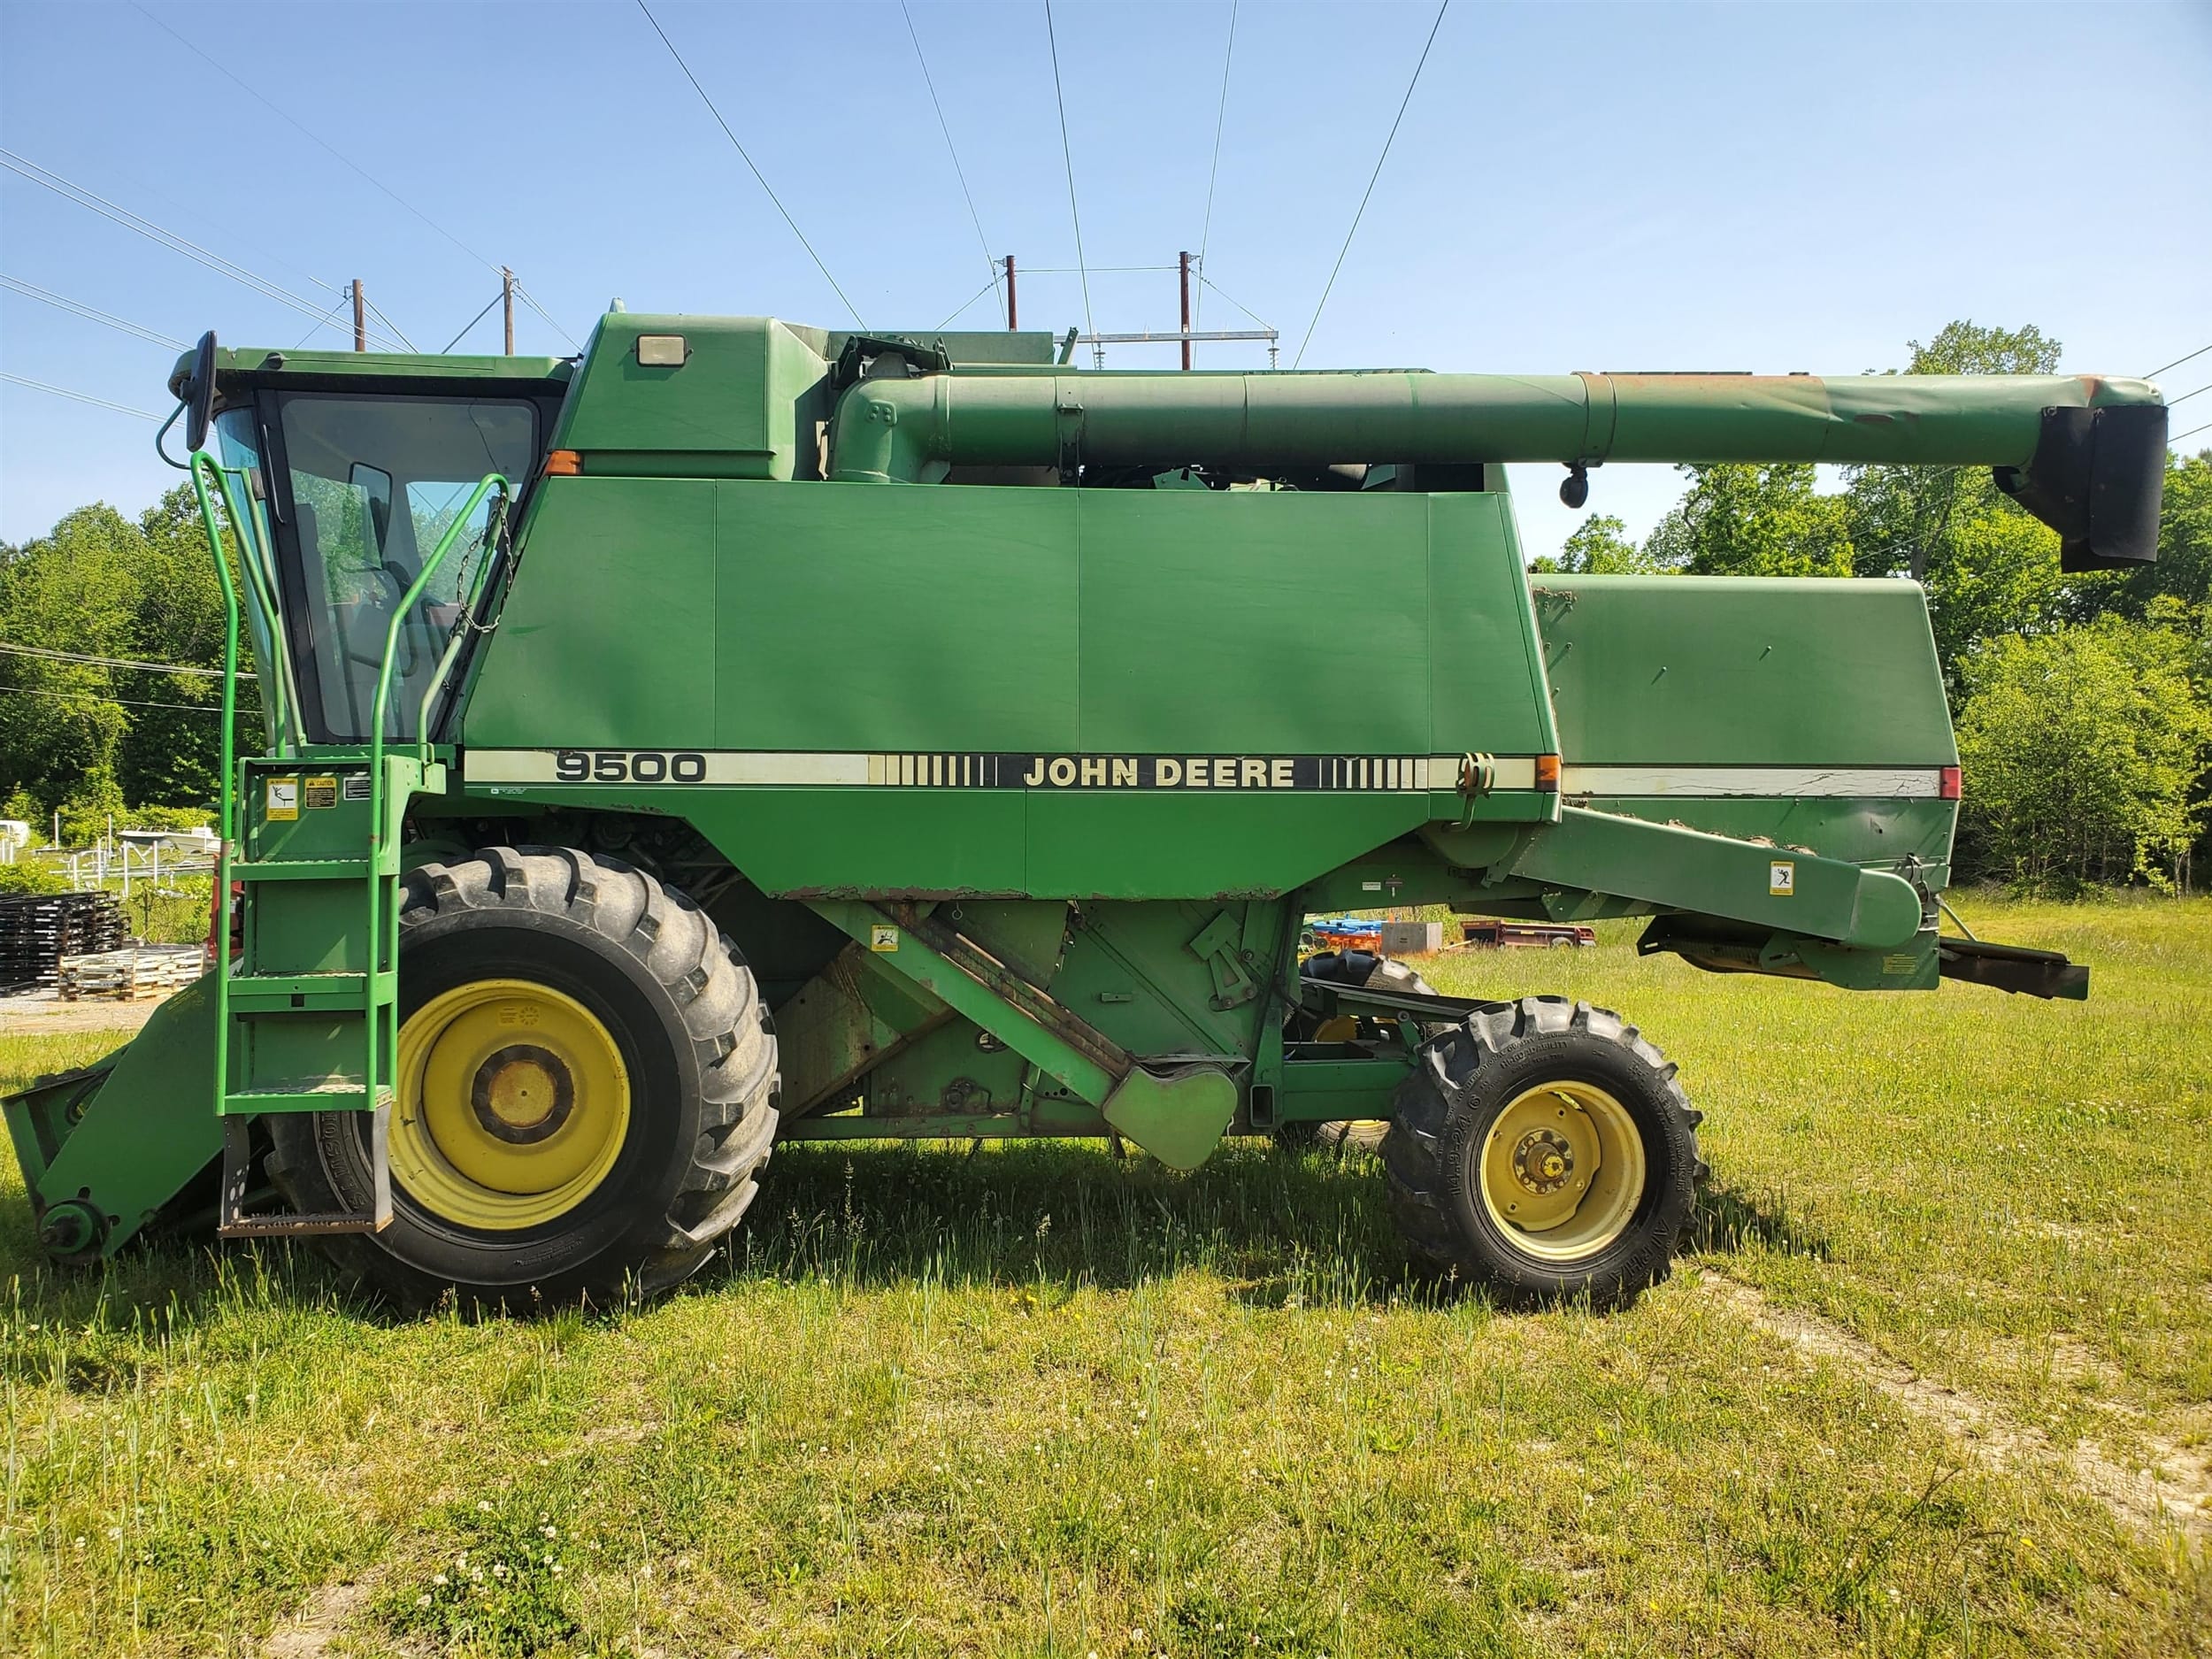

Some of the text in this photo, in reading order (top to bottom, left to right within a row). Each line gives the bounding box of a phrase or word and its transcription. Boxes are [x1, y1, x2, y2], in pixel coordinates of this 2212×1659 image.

[557, 753, 707, 782] 9500
[1025, 758, 1294, 787] JOHN DEERE
